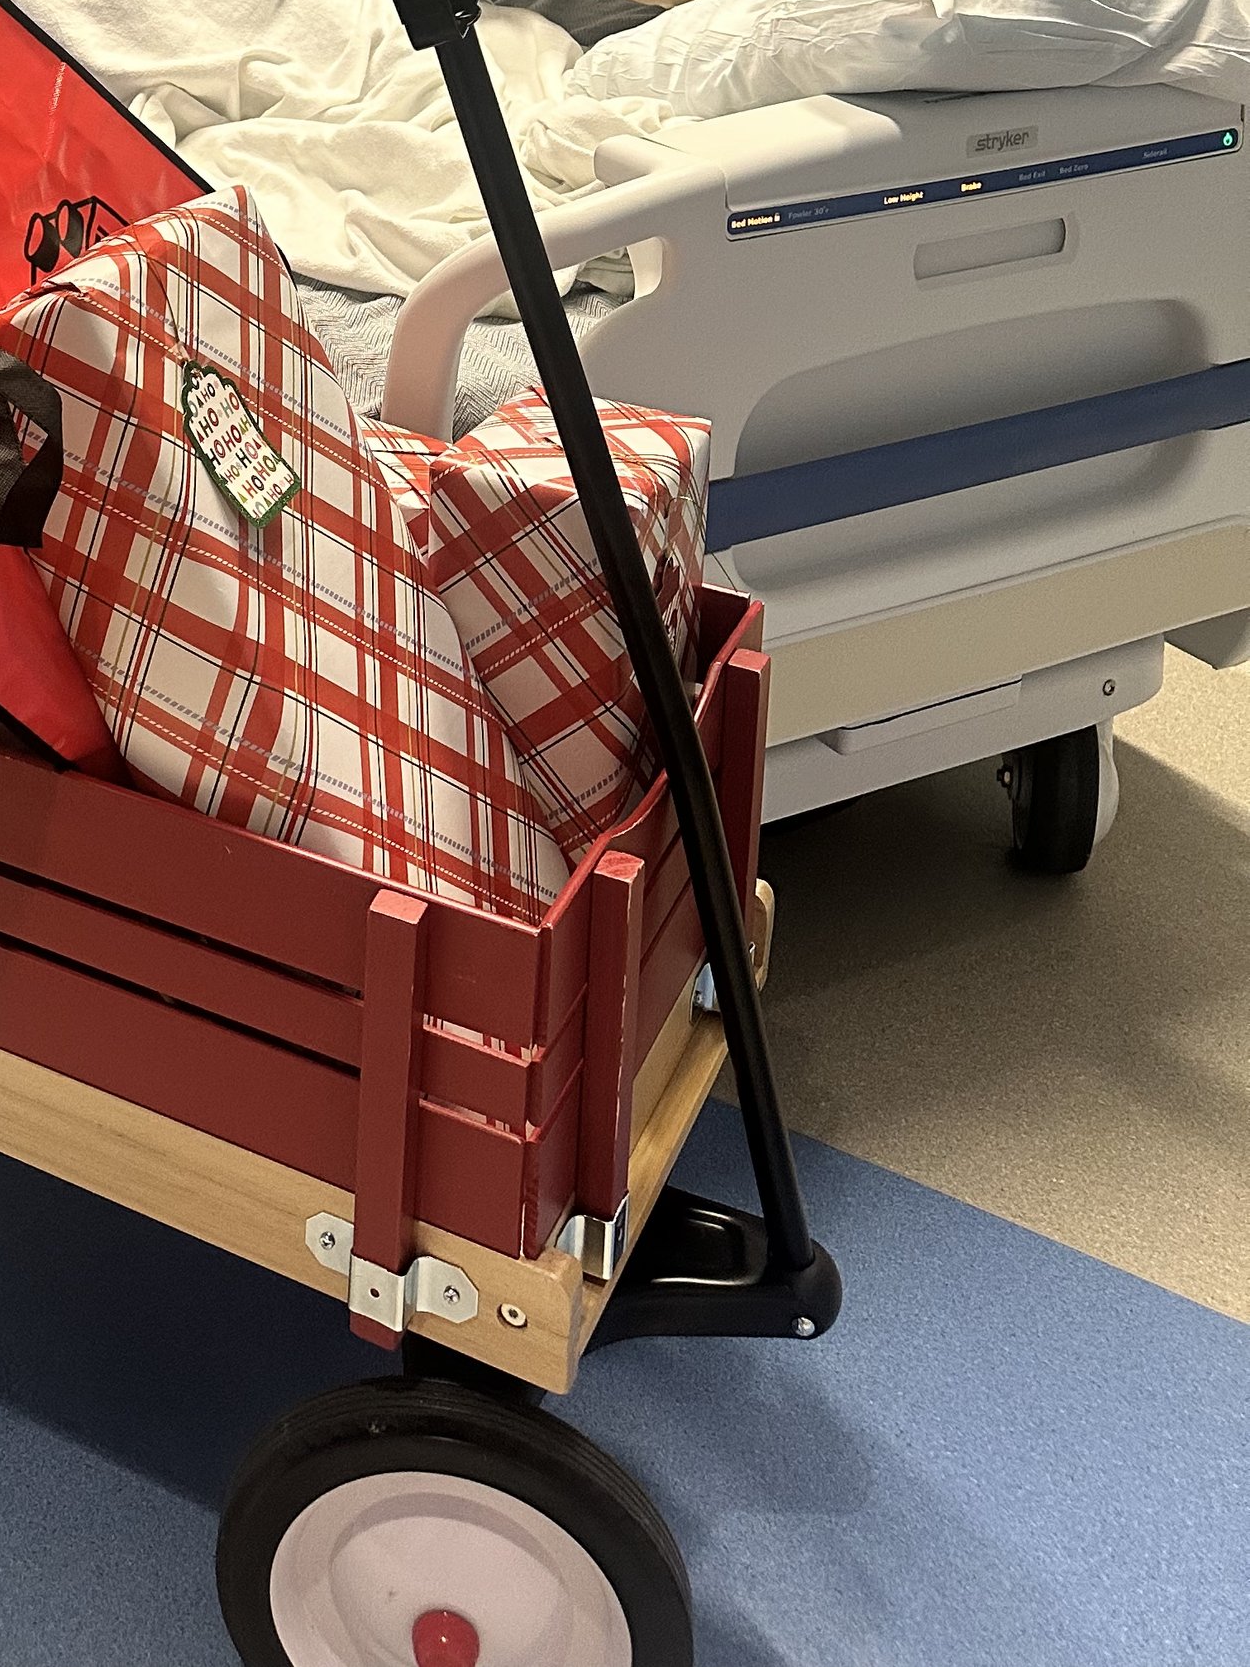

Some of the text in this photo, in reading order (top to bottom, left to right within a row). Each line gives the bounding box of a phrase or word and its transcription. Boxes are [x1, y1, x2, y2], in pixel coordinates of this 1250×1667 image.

[975, 130, 1030, 152] stryker
[884, 191, 925, 206] Low Height
[731, 218, 746, 229] Bed
